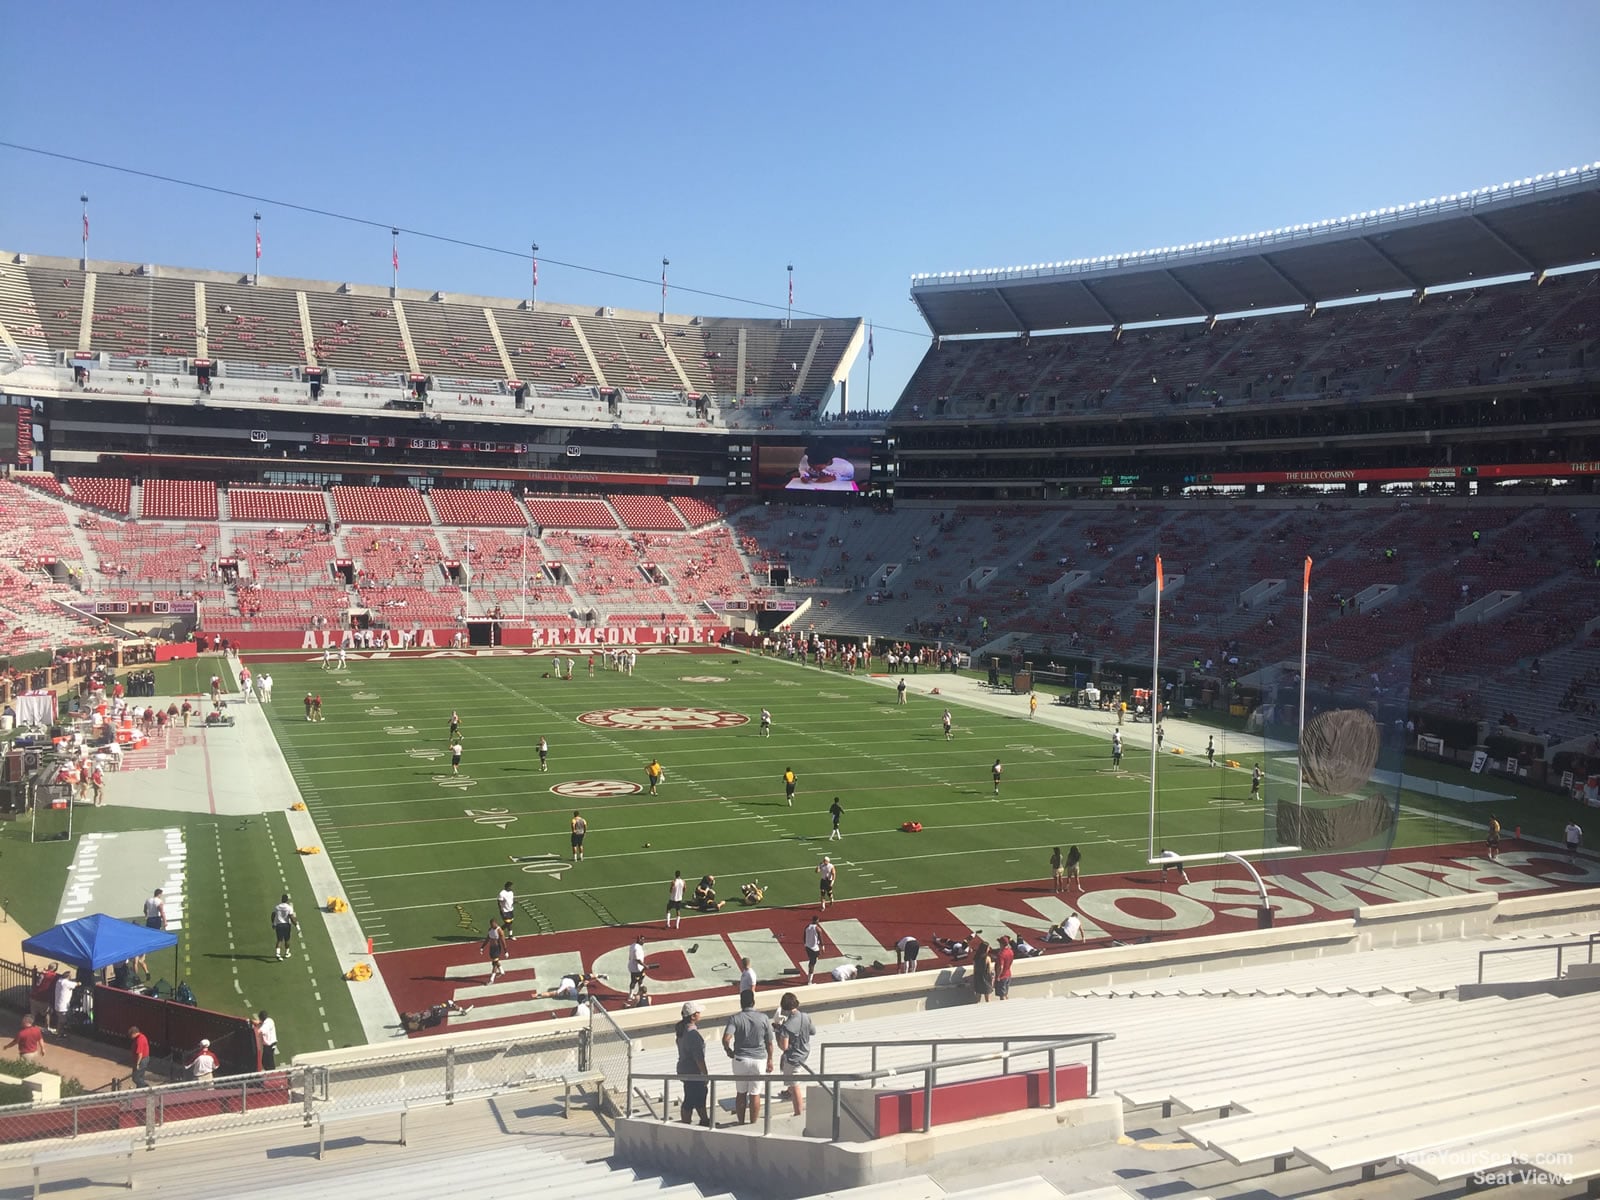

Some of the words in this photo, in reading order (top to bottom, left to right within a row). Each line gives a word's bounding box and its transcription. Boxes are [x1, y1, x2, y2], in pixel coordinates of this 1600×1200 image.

[17, 407, 32, 464] ALABAMA
[563, 473, 599, 481] COMPANY
[1285, 472, 1300, 480] THE
[1301, 471, 1319, 480] LILLY
[1320, 471, 1355, 480] COMPANY
[1571, 463, 1588, 472] THE
[463, 807, 518, 824] 20
[508, 853, 573, 874] 10
[946, 851, 1600, 950] CRIMSON
[444, 916, 939, 1026] TIDE
